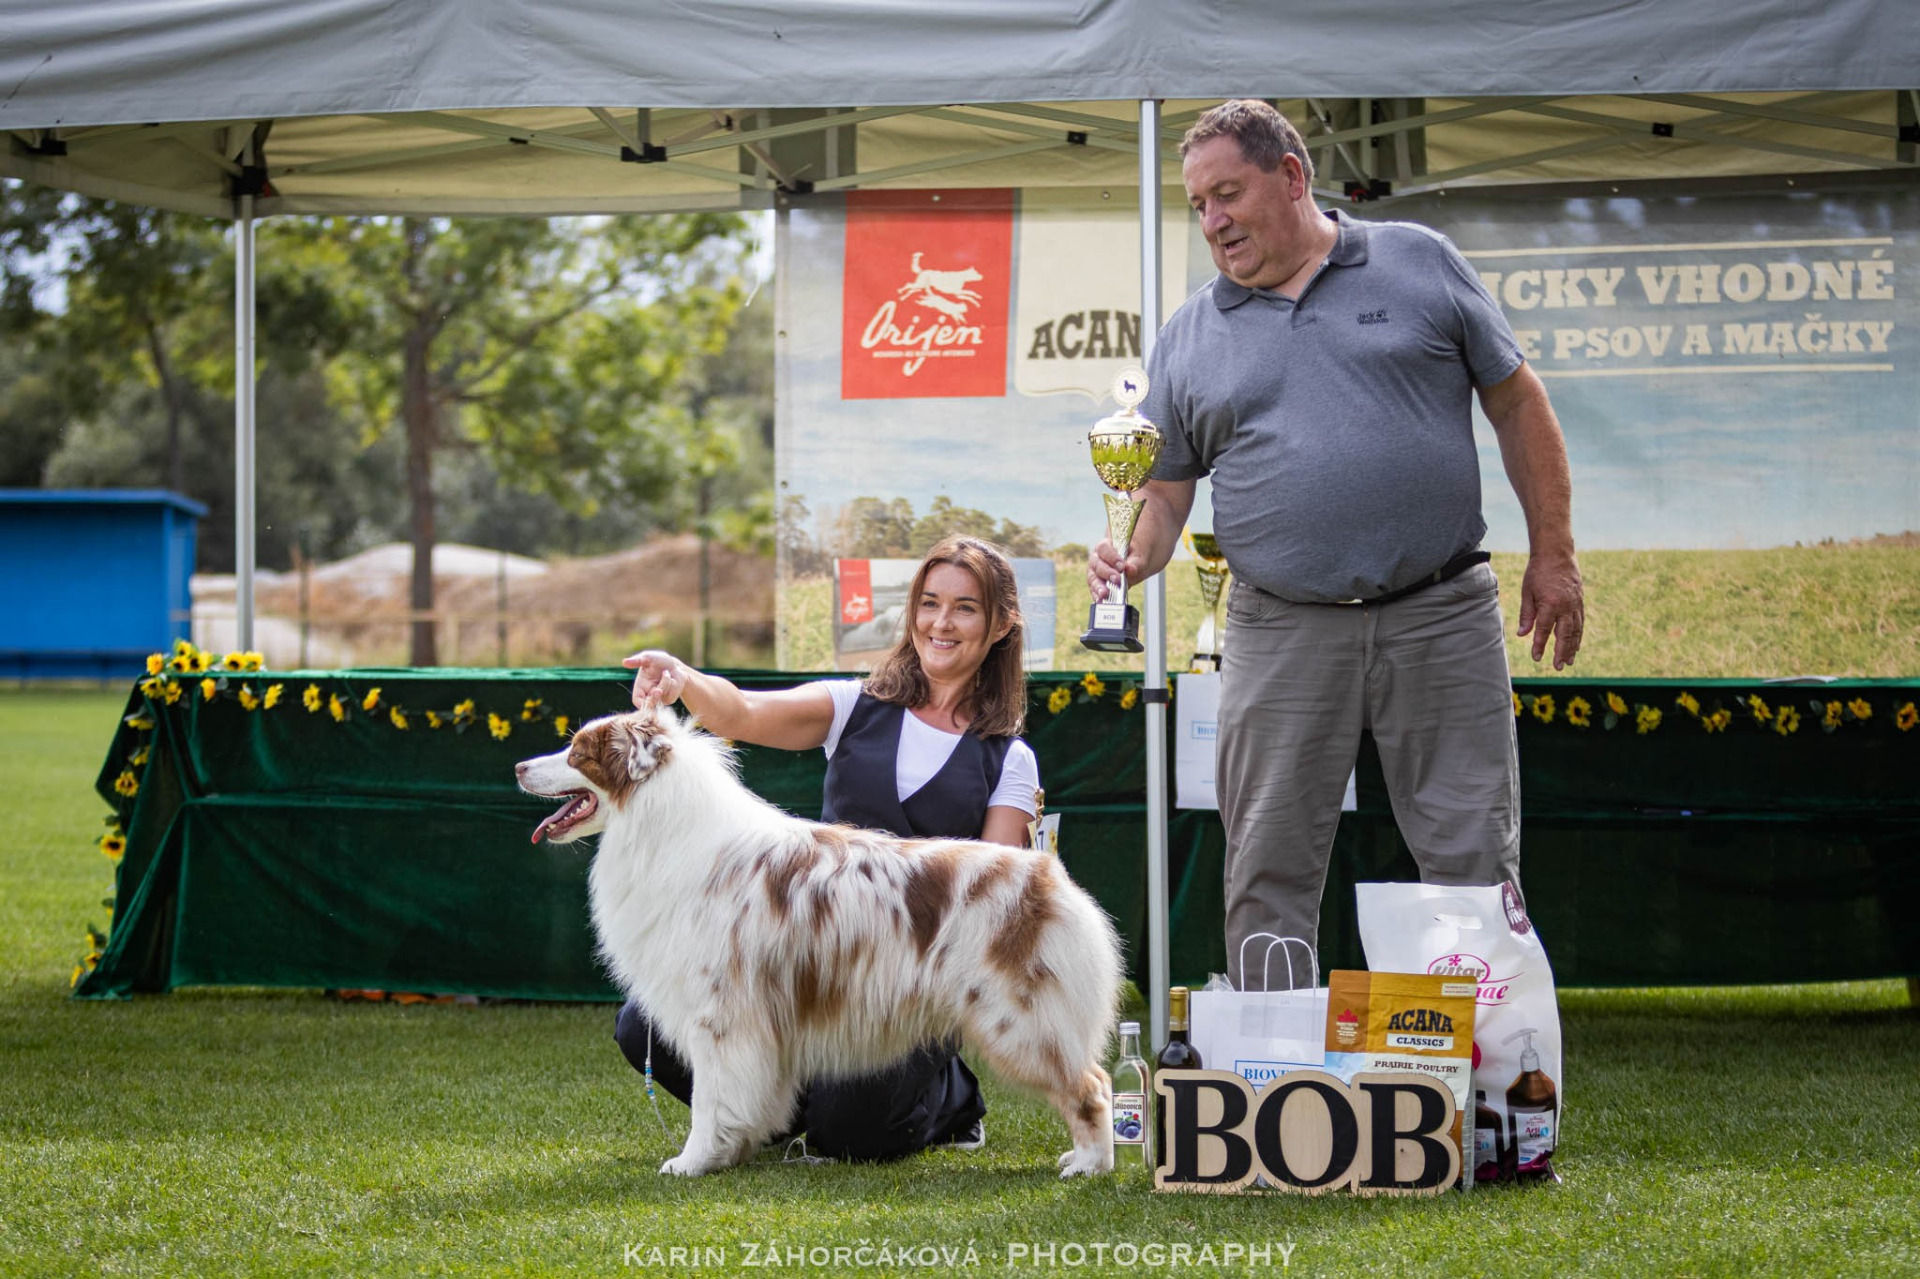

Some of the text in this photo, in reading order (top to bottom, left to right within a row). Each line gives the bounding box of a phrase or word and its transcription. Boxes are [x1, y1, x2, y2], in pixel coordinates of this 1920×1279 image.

[1480, 249, 1895, 310] ICKY VHODNÉ
[860, 300, 983, 376] Orijen
[1027, 309, 1142, 359] ACAN
[1514, 313, 1895, 360] E PSOV A MAČKY
[1387, 1009, 1455, 1033] ACANA
[1396, 1036, 1445, 1047] CLASSICS
[1244, 1068, 1292, 1081] BIOV
[1374, 1060, 1414, 1070] PRAIRIE
[1416, 1063, 1459, 1074] POULTRY
[1163, 1079, 1452, 1190] BOB
